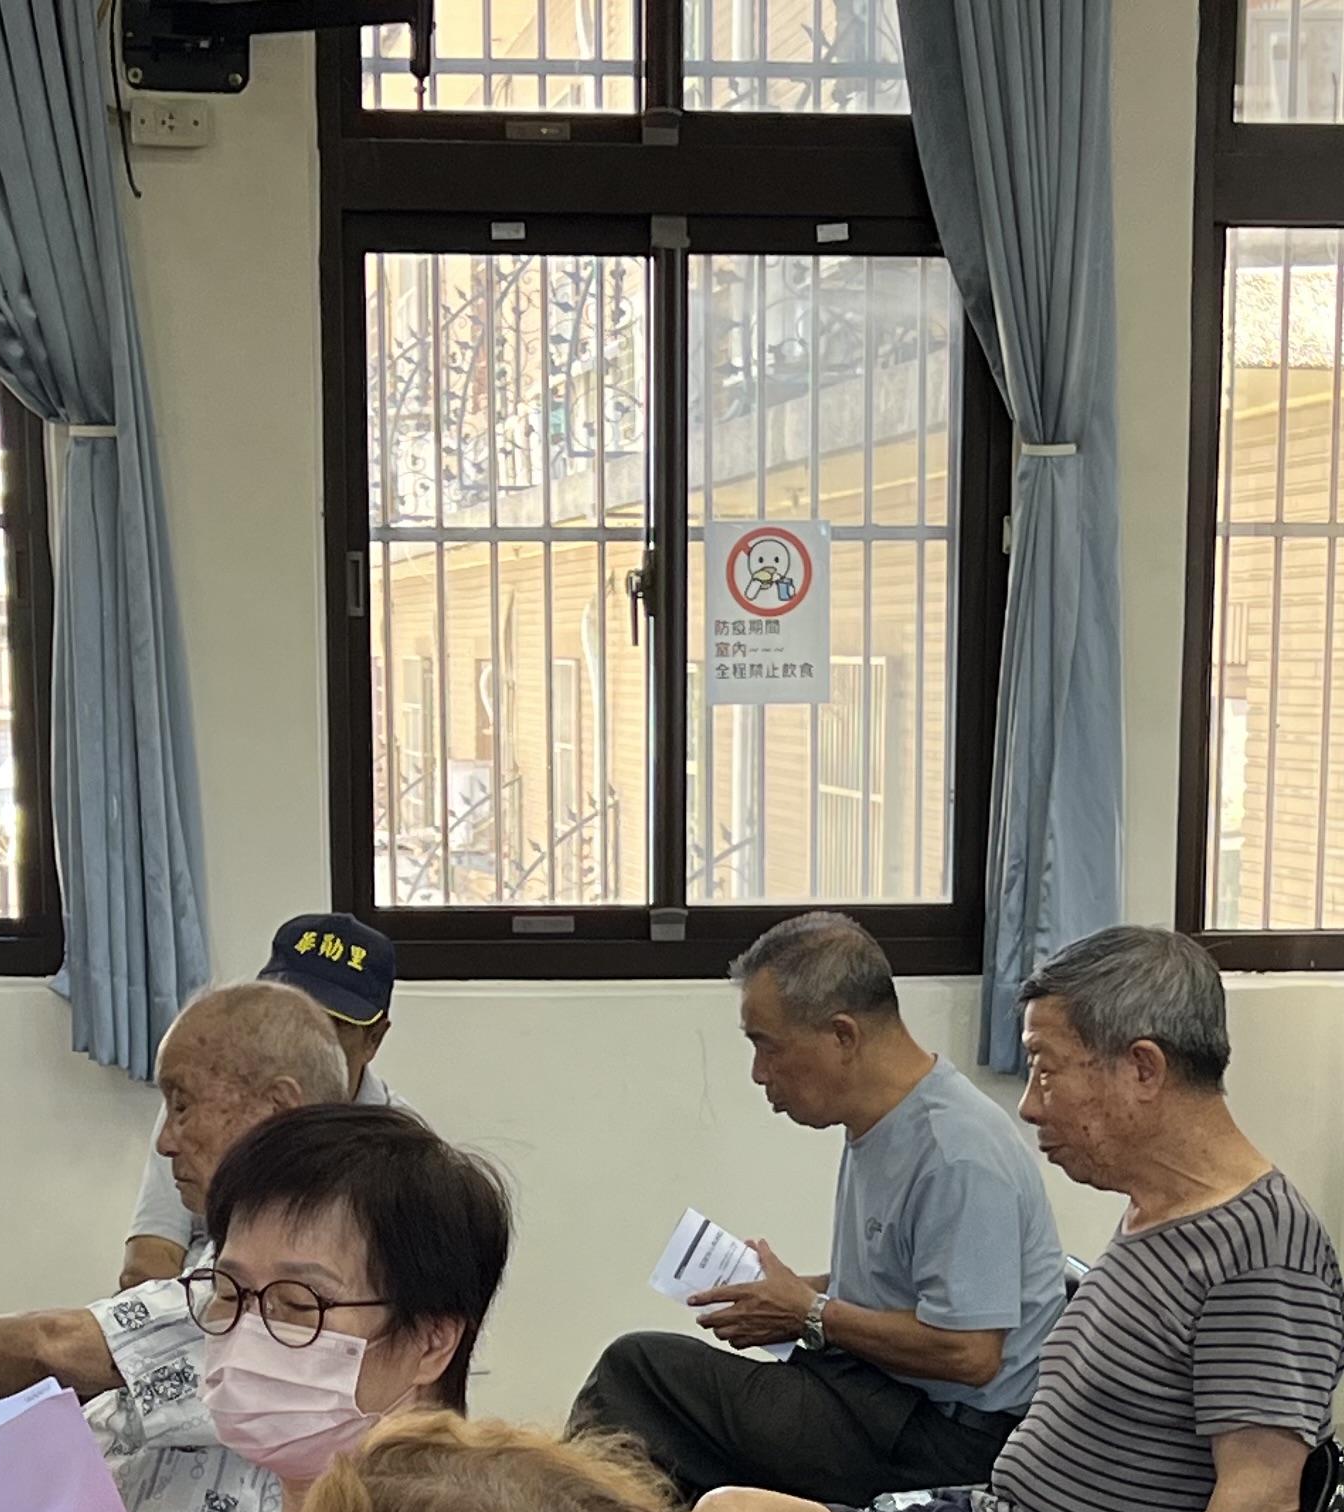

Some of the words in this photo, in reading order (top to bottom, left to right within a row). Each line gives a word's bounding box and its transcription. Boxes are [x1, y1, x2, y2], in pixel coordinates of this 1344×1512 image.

[714, 619, 781, 636] 防疫期間
[715, 662, 814, 680] 全程禁止飲食
